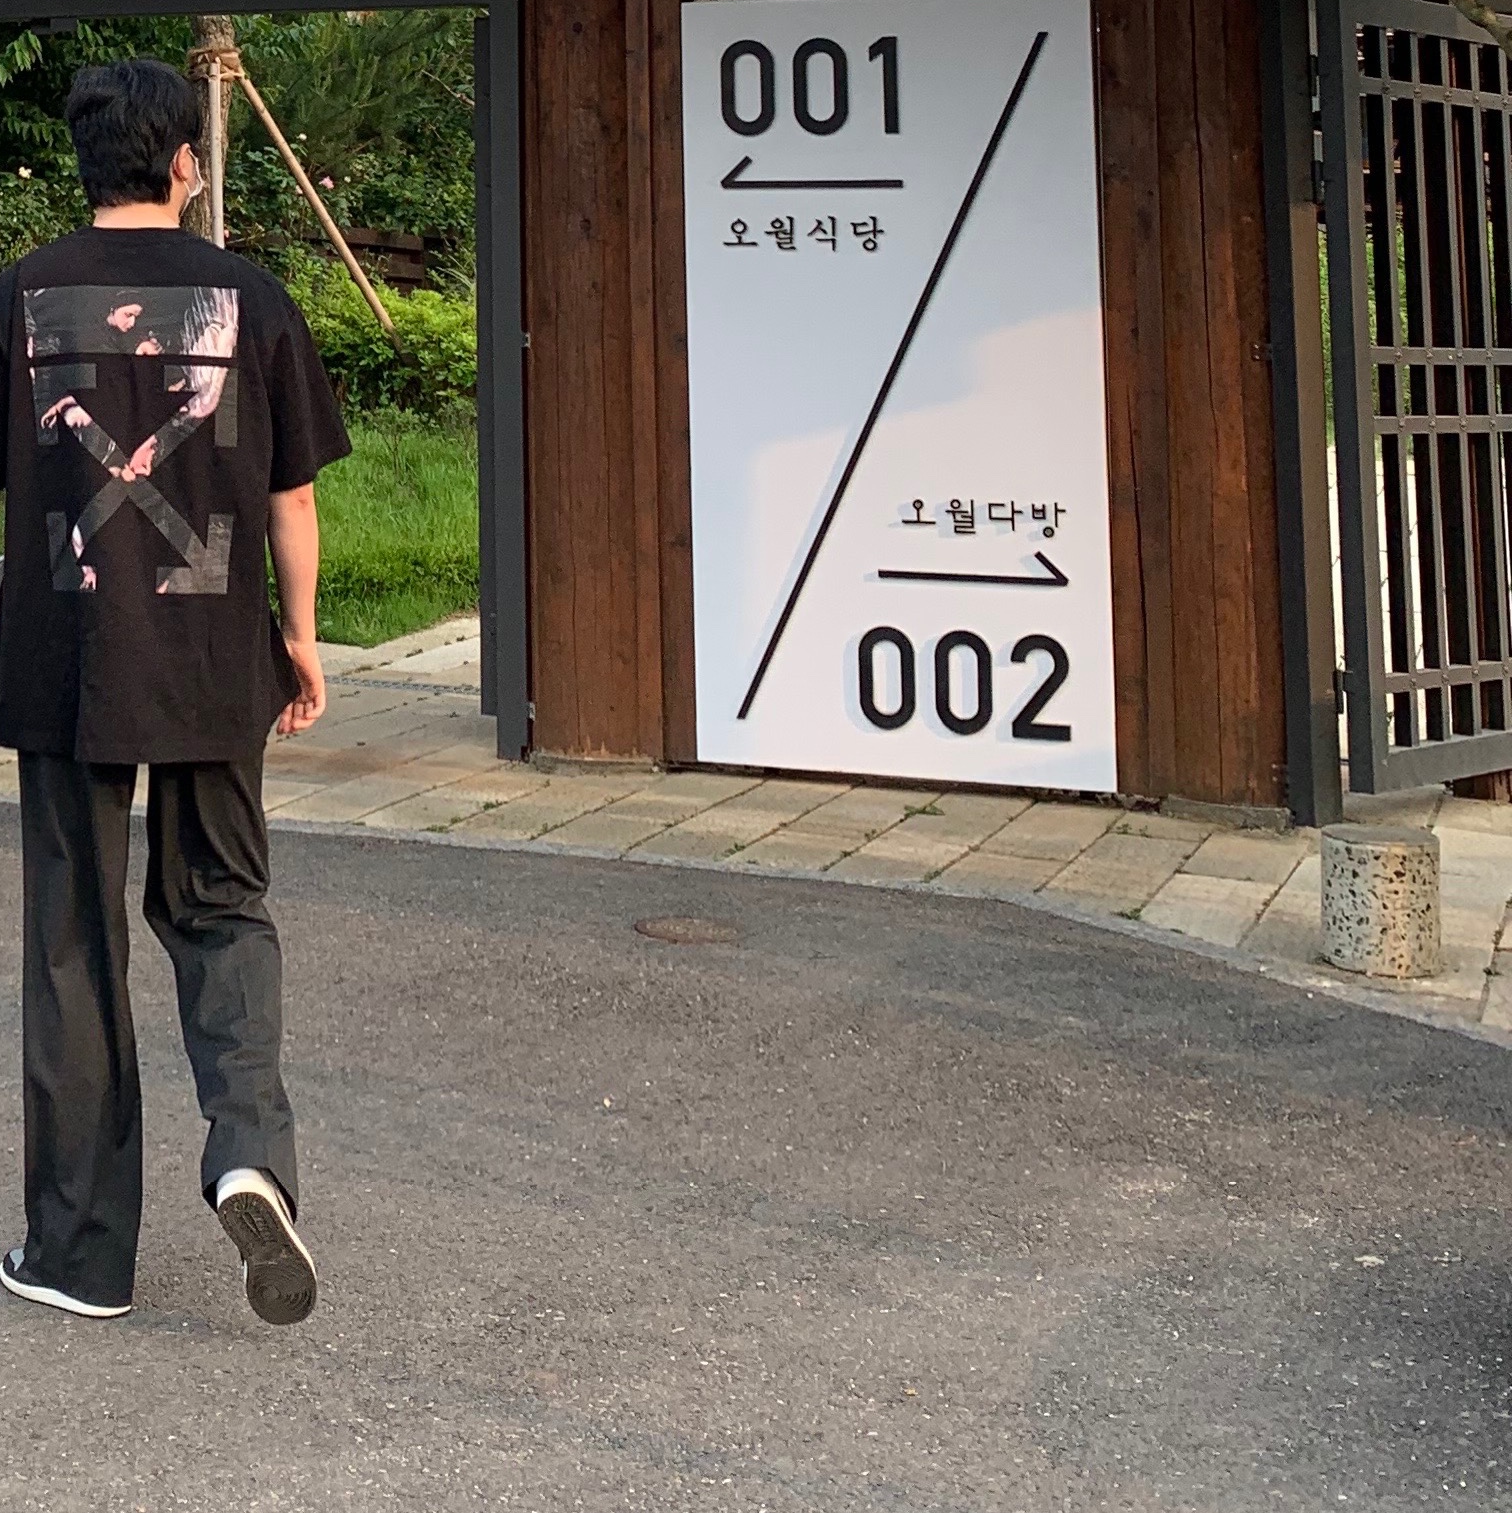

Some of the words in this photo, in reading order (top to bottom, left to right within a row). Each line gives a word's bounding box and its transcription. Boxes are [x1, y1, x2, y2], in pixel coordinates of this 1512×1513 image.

[719, 35, 901, 138] 001
[723, 215, 885, 253] 오월식당
[901, 498, 1066, 539] 오월다방
[858, 626, 1071, 742] 002
